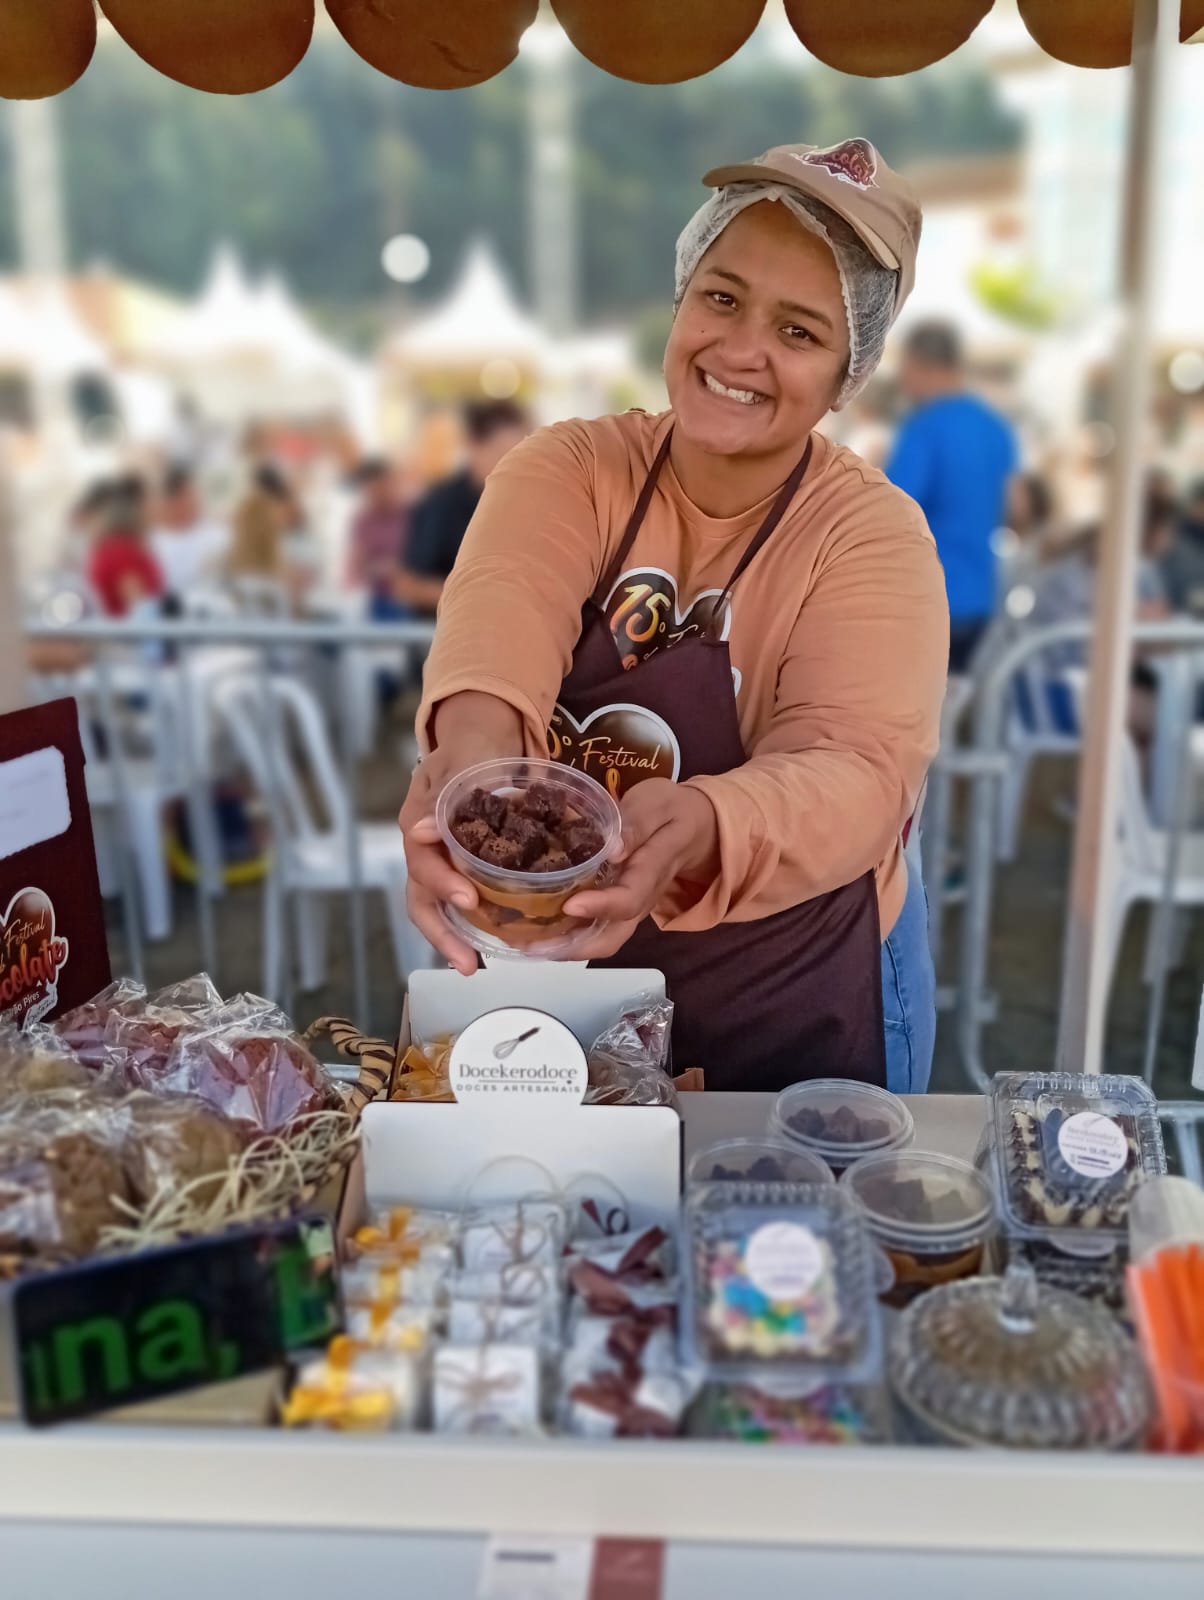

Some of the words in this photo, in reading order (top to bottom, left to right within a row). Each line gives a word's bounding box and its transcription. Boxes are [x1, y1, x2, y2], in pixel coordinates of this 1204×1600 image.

[579, 736, 661, 771] Festival
[3, 908, 46, 958] Festival
[459, 1063, 578, 1079] Docekerodoce
[456, 1083, 498, 1092] DOCES
[503, 1084, 581, 1093] ARTESANAIS
